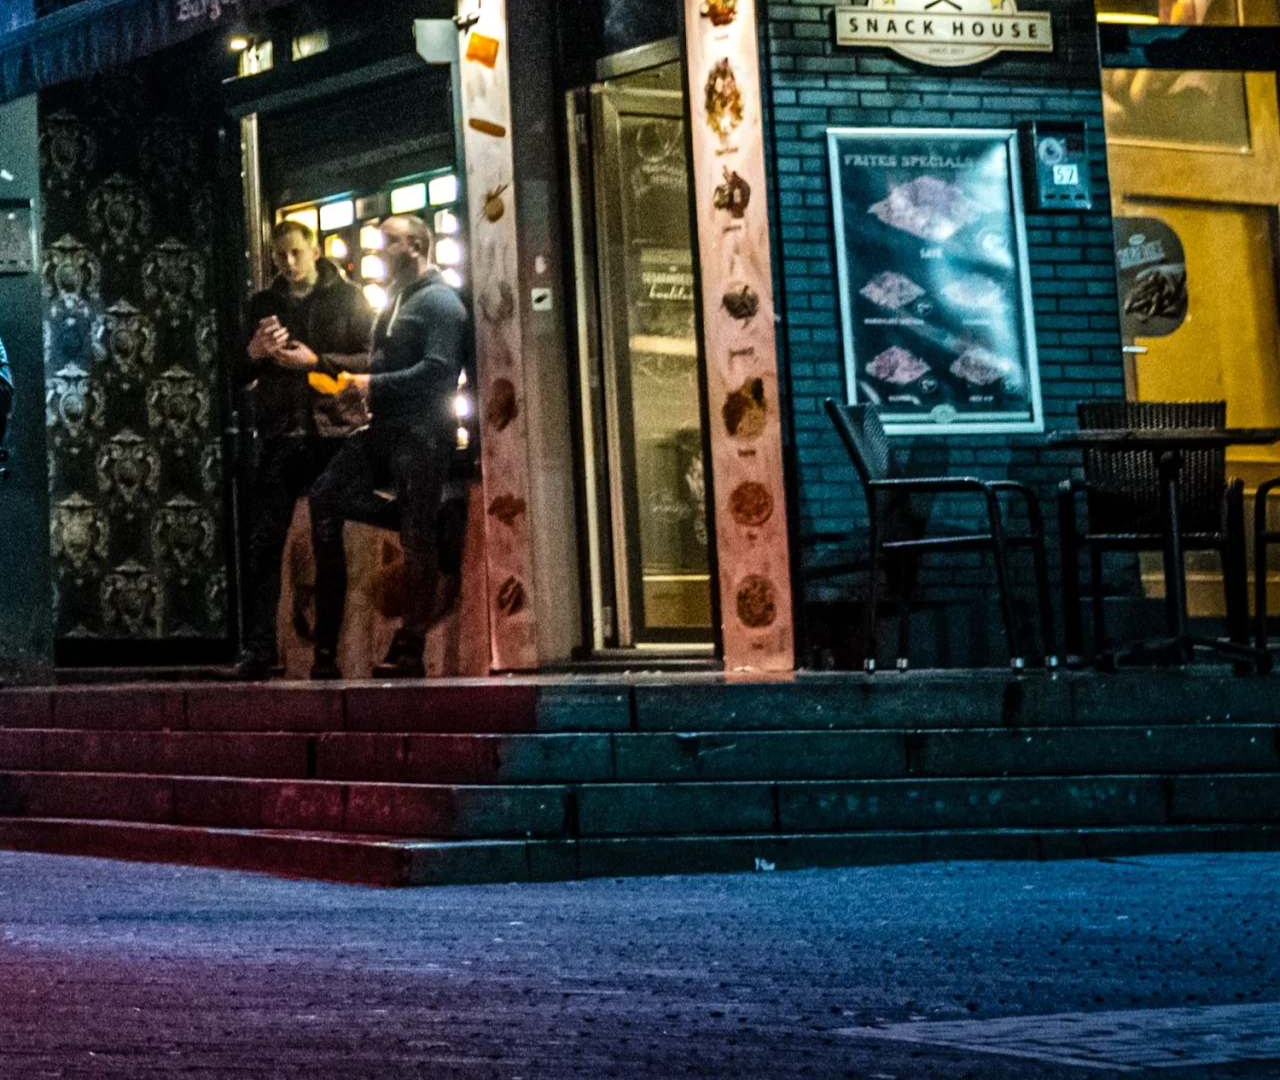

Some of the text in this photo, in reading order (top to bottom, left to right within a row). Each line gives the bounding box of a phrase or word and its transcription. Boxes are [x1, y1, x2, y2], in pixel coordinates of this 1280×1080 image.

[848, 16, 1039, 39] SNACK HOUSE
[843, 154, 897, 168] FRITES
[1055, 167, 1074, 181] 57
